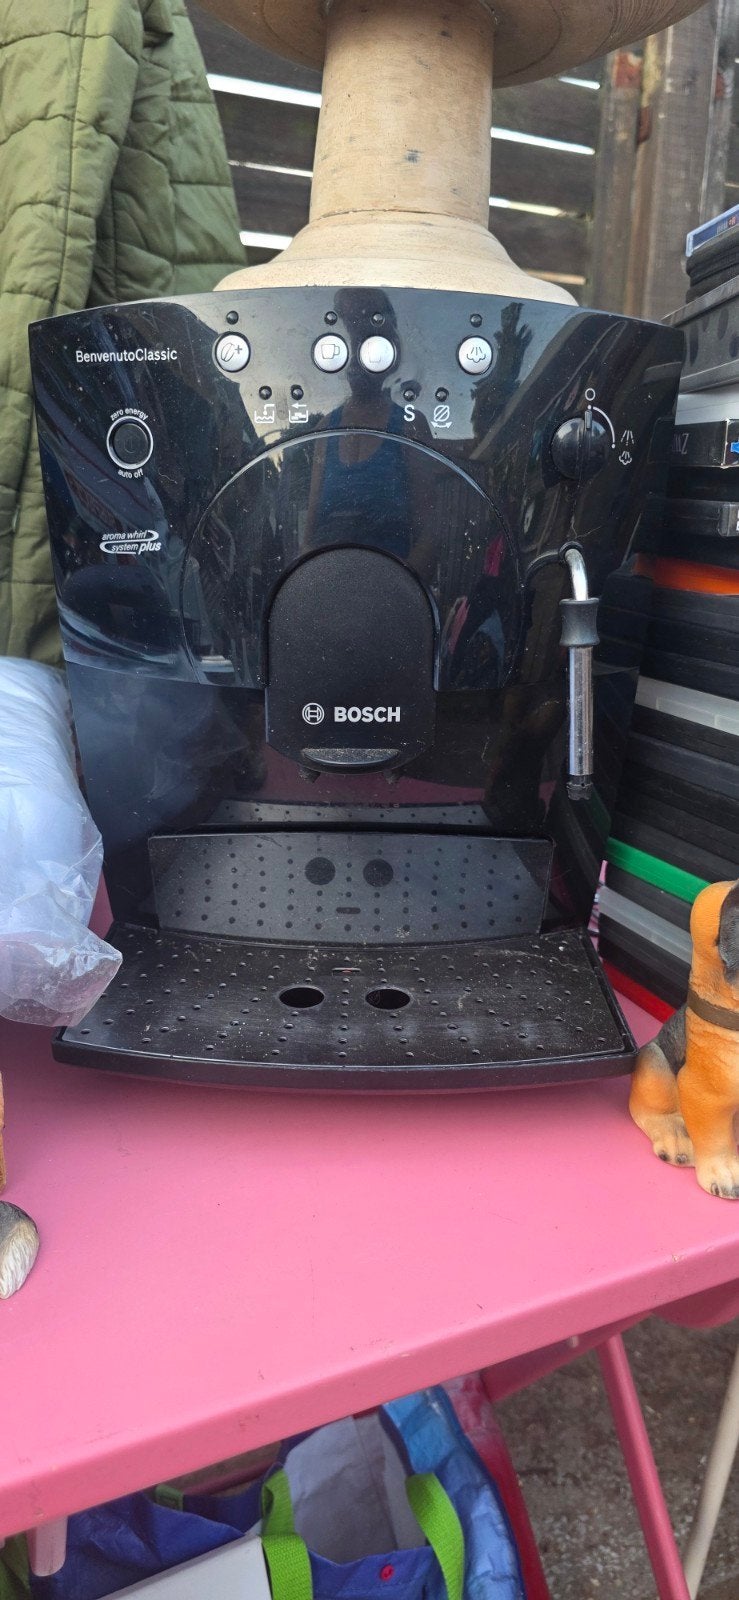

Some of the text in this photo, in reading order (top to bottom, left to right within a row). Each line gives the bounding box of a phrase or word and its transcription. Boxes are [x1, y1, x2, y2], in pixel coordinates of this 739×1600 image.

[75, 347, 178, 363] BenvenutoClassic
[110, 407, 149, 421] zero energy
[403, 404, 416, 422] S
[117, 467, 144, 479] auto off
[101, 530, 148, 541] aroma whirl
[111, 541, 162, 555] system plus
[334, 706, 401, 723] BOSCH
